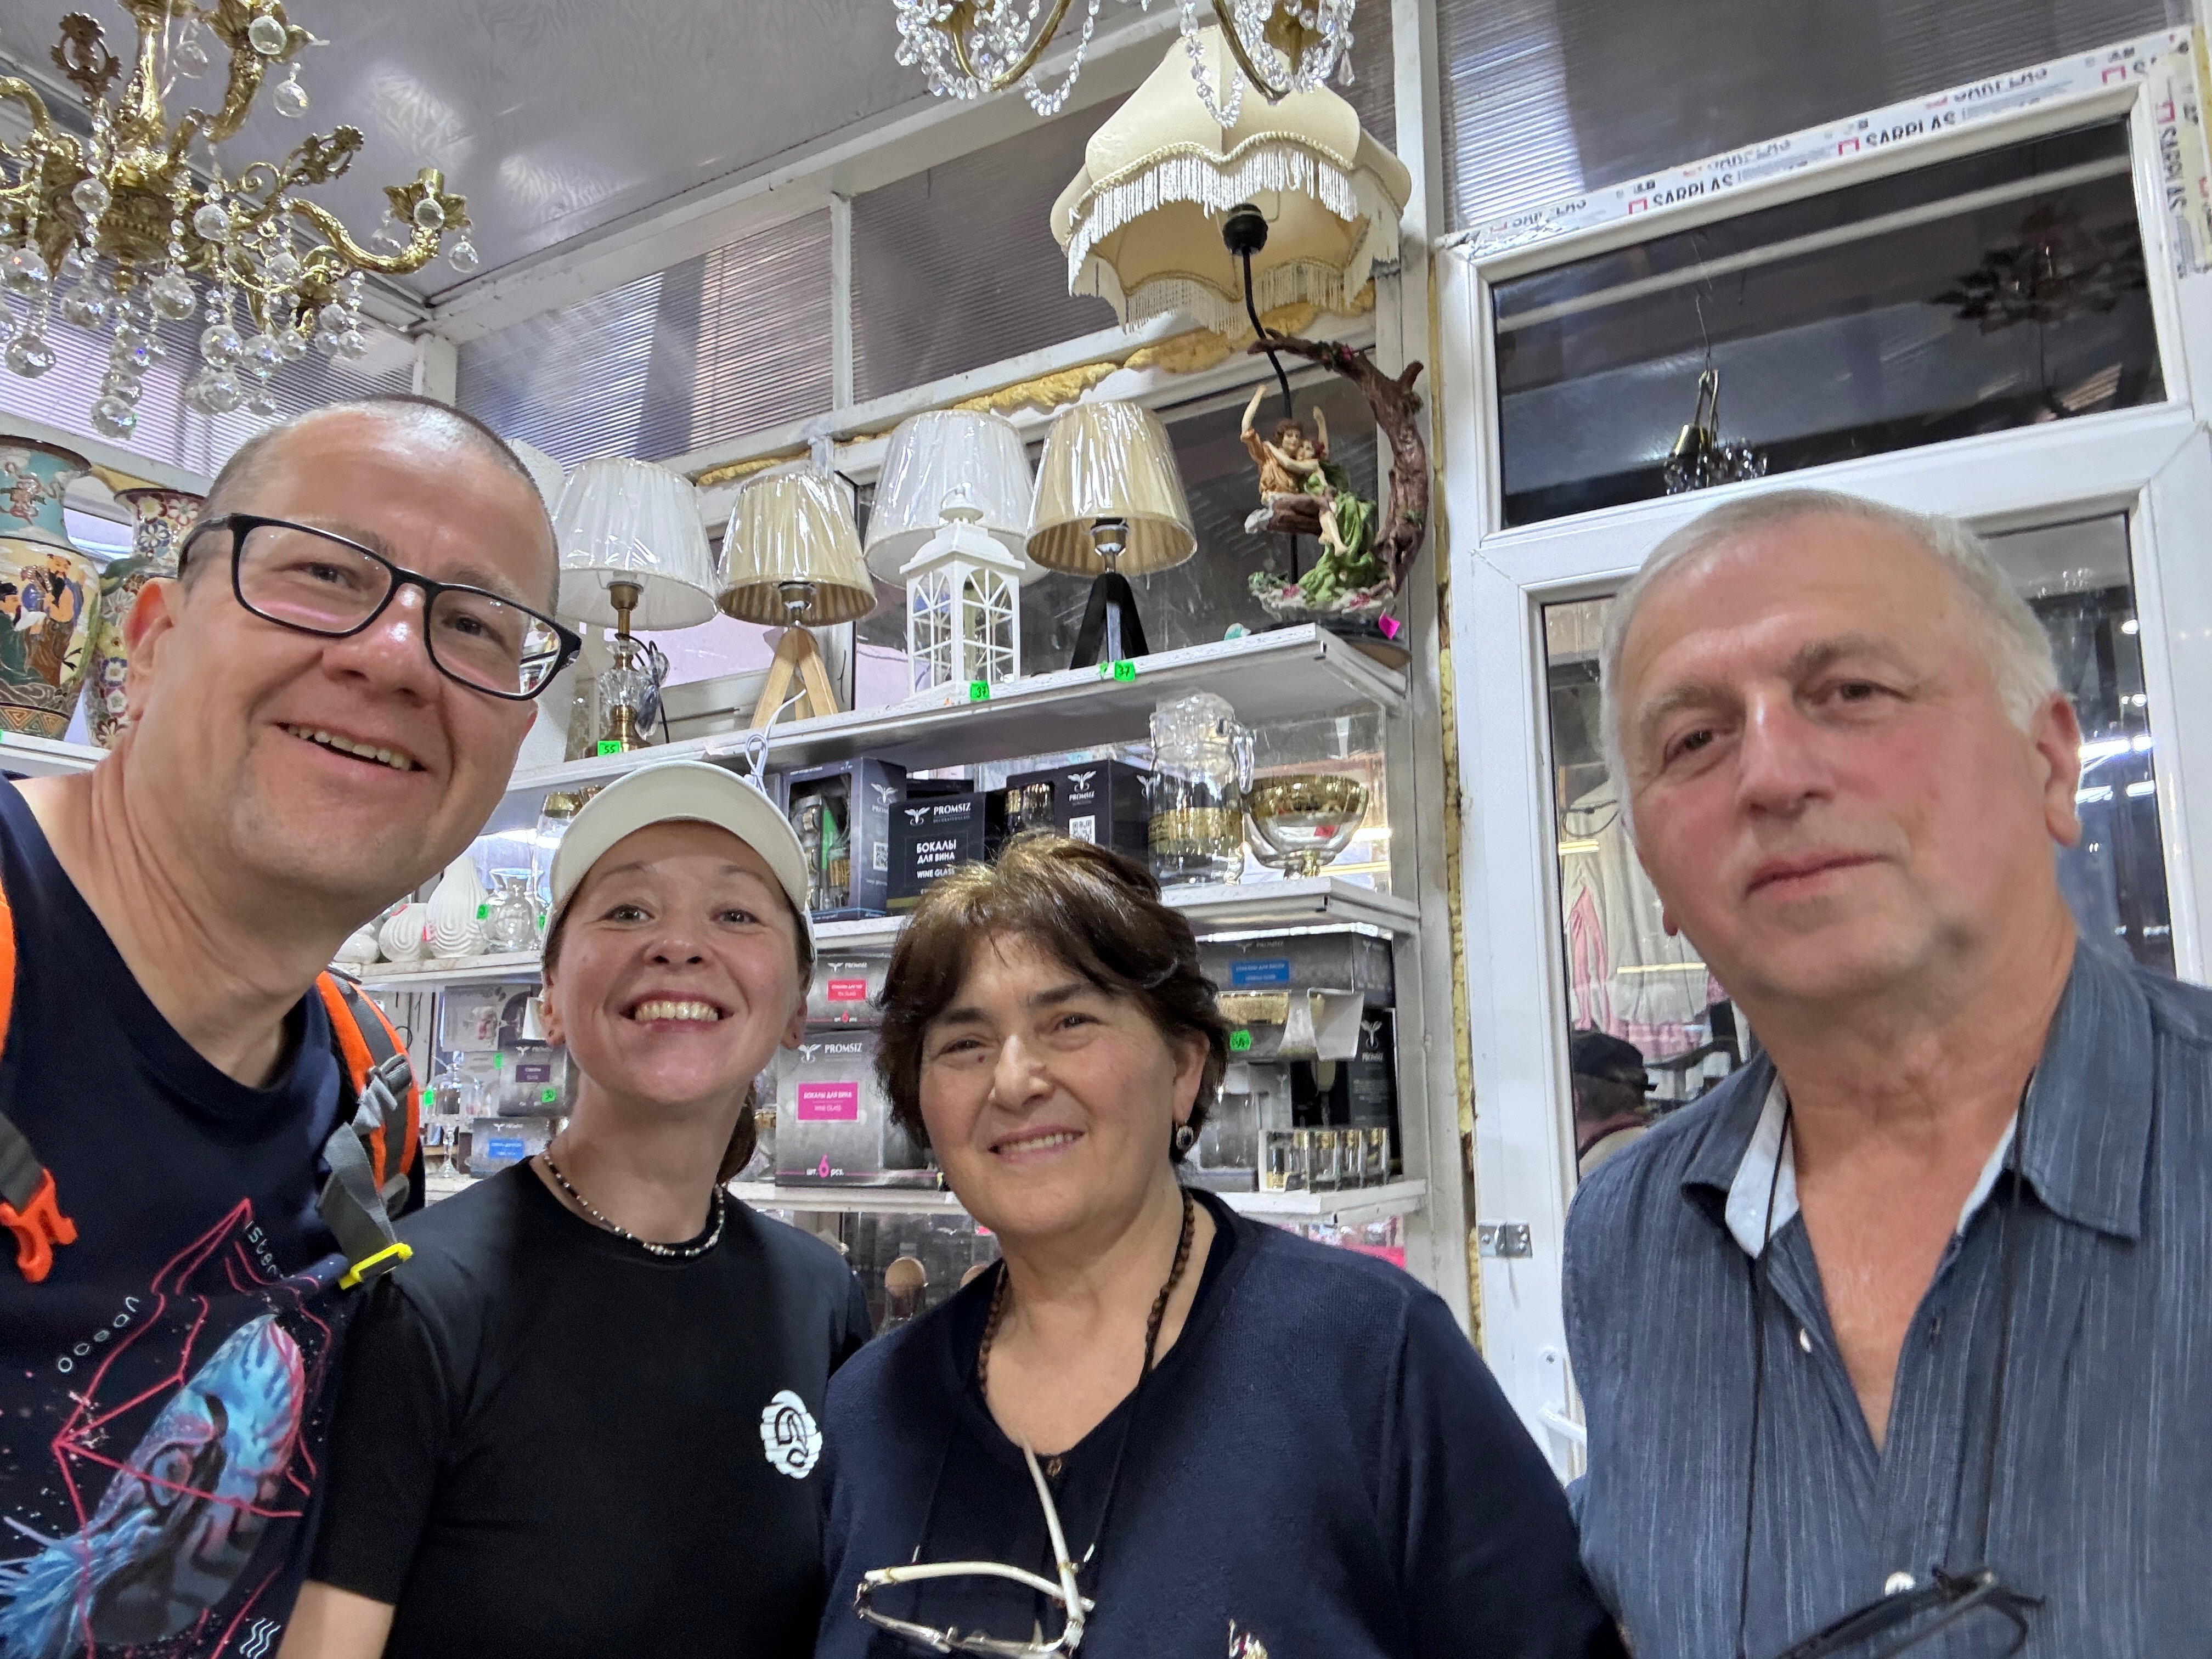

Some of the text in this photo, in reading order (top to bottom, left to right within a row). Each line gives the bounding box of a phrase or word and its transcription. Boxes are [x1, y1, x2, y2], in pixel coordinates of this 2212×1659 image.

[977, 685, 986, 698] 37
[604, 744, 616, 754] 55
[933, 802, 971, 815] PROMSIZ
[916, 839, 956, 854] БОКАЛЫ
[917, 851, 955, 865] ДЛЯ ВИНА
[917, 869, 934, 879] WINE
[825, 1042, 863, 1054] PROMSIZ
[58, 1296, 139, 1373] Ocean
